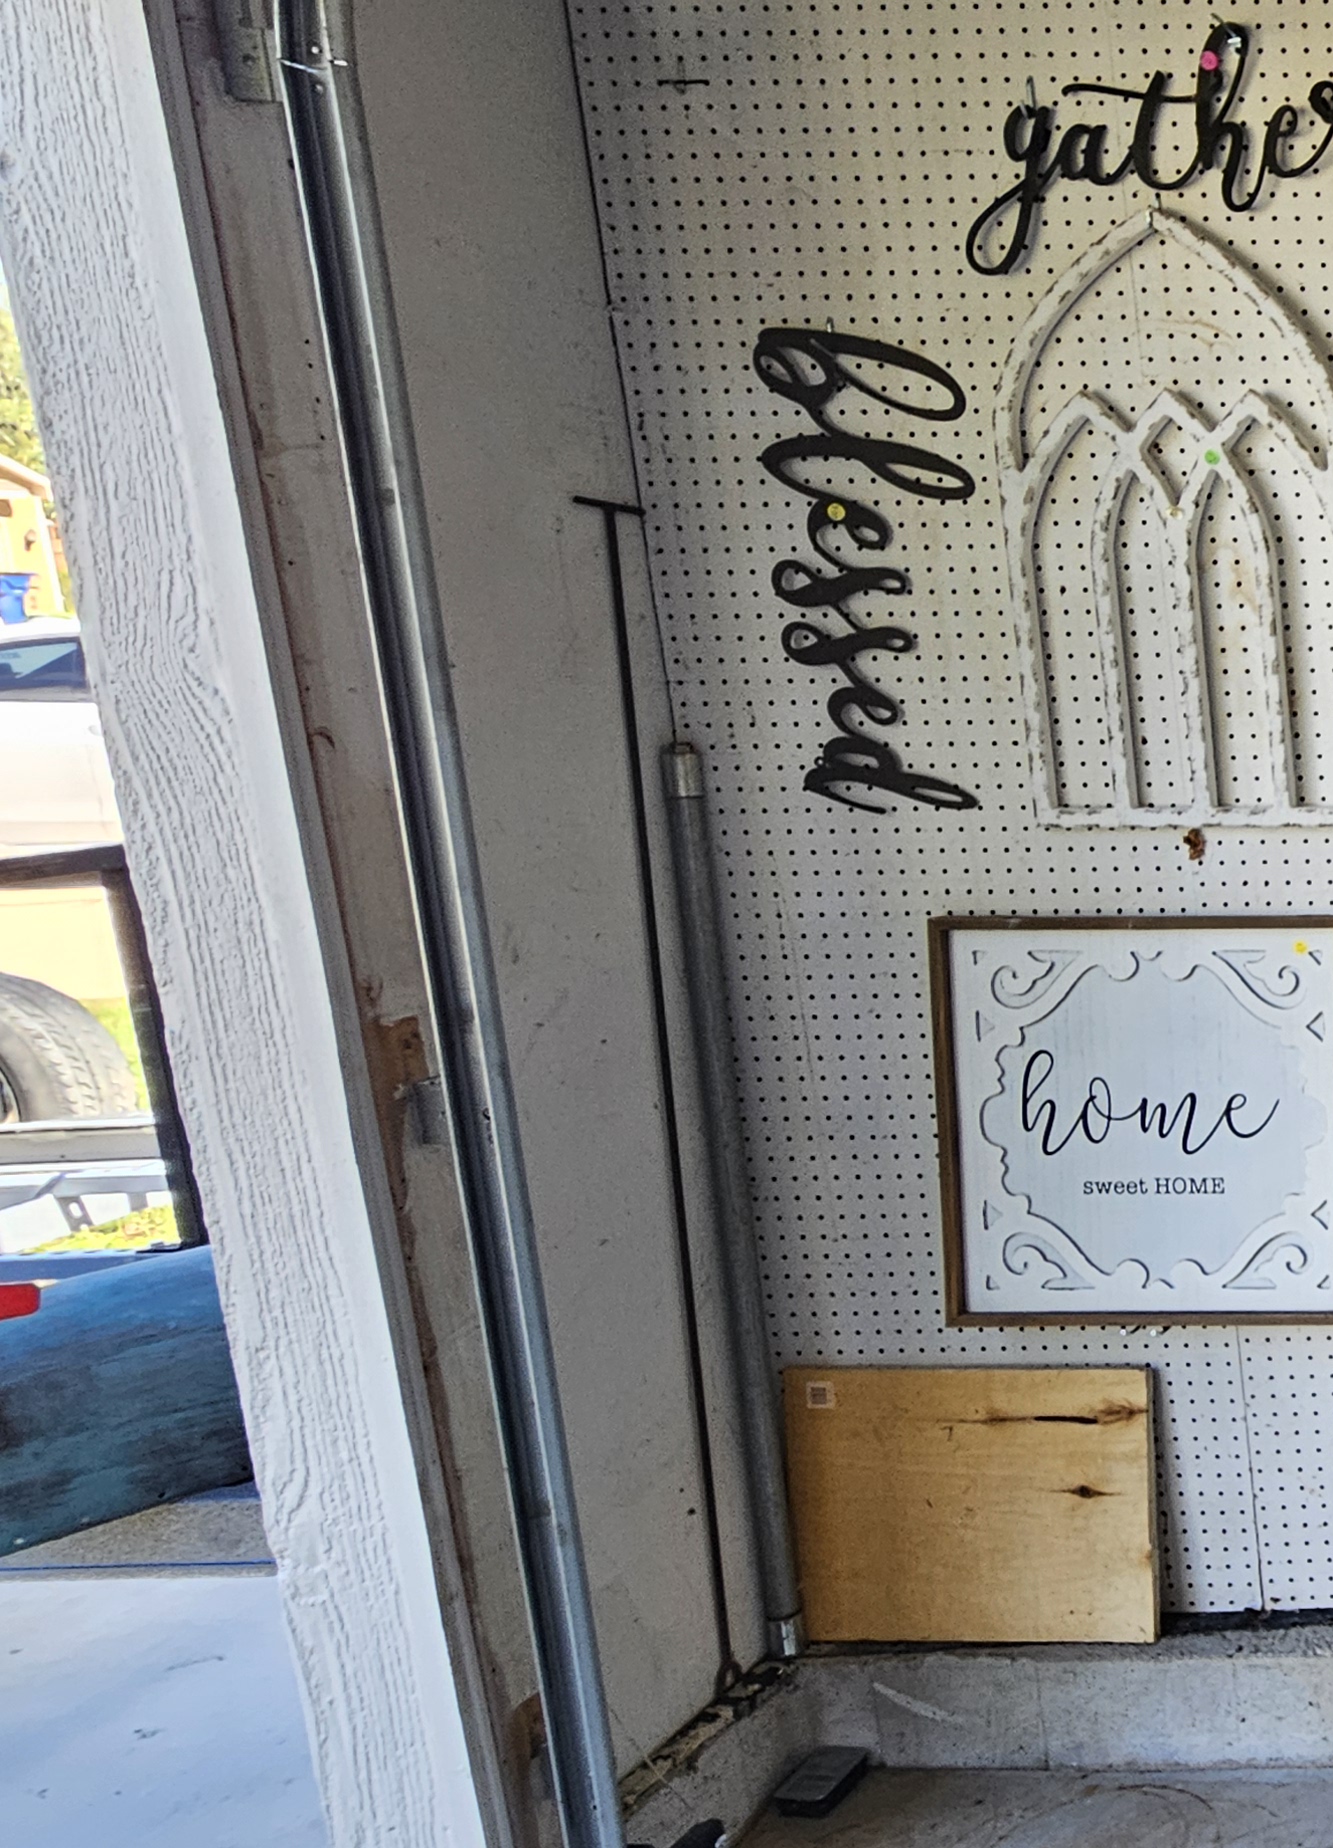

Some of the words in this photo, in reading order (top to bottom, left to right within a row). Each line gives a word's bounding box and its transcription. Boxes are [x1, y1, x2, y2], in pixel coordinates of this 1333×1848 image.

[752, 326, 979, 814] blessed
[1021, 1049, 1280, 1156] home
[1082, 1177, 1148, 1196] sweet
[1154, 1176, 1226, 1196] HOME
